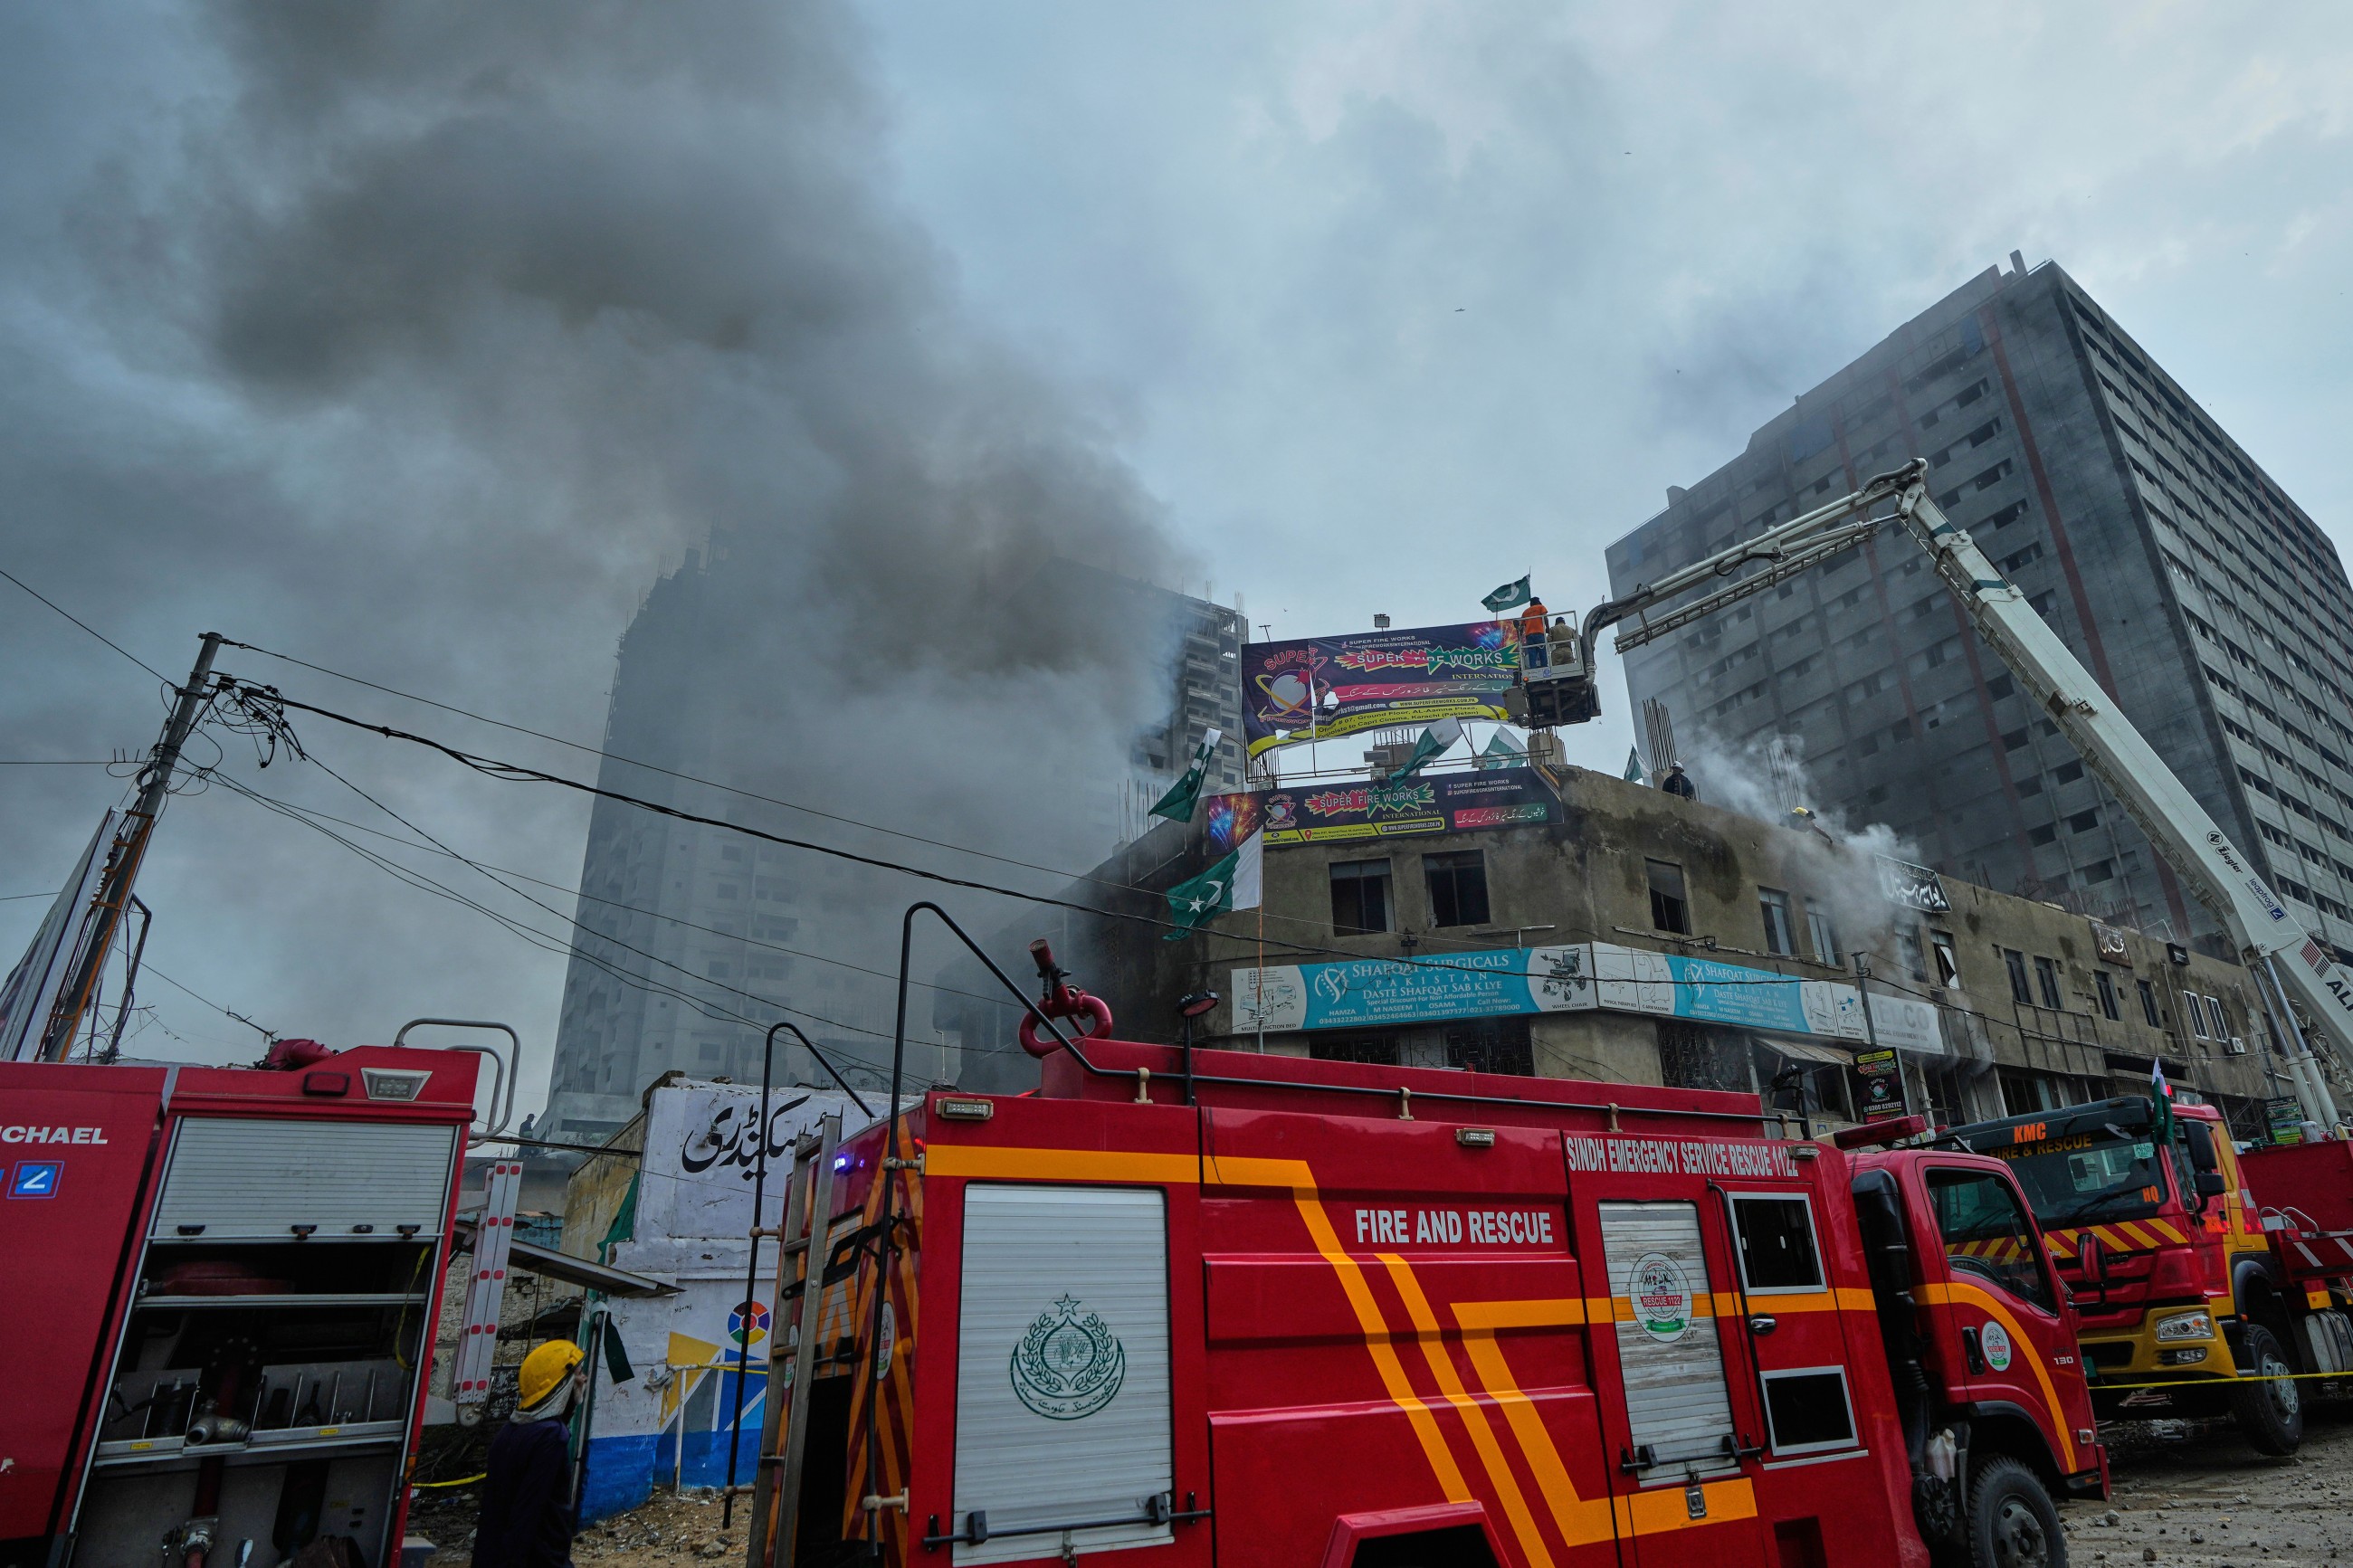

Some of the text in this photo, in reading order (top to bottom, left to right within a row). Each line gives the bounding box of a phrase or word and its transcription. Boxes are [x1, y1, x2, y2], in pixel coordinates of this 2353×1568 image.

[1450, 653, 1503, 664] WORKS
[1400, 698, 1476, 707] WWW.SUPERFIREWORKS.COM.PK
[1358, 711, 1386, 721] Ground
[1389, 708, 1411, 717] Floor,
[1453, 784, 1522, 795] SUPERFIREWORKSINTERNATIONAL
[1320, 791, 1419, 808] SUPER FIRE WORKS
[1383, 810, 1442, 820] INTERNATIONAL
[1388, 821, 1441, 832] WWW.SUPERFIREWORKS.COM.PK
[2215, 846, 2243, 874] Ziegler
[2249, 878, 2275, 908] leapfrog
[1353, 955, 1509, 979] SHAFQAT SURGICALS
[1705, 965, 1744, 980] SHAFQAT
[1376, 973, 1487, 987] PAKISTAN
[1363, 980, 1502, 1000] DASTE SHAFQAT SAB K LYE
[1379, 1004, 1413, 1012] NASEEM
[1491, 997, 1511, 1005] Now:
[1389, 996, 1416, 1004] Discount
[1444, 992, 1477, 1000] Affordable
[1871, 1078, 1886, 1086] SUPER
[2014, 1122, 2046, 1144] KMC
[2023, 1145, 2033, 1157] &
[2036, 1133, 2092, 1155] RESCUE
[1567, 1136, 1606, 1172] SINDH
[1606, 1139, 1678, 1174] EMERGENCY
[1681, 1142, 1729, 1175] SERVICE
[1729, 1145, 1773, 1176] RESCUE
[2142, 1185, 2159, 1203] HQ
[1356, 1209, 1553, 1244] FIRE AND RESCUE
[1643, 1297, 1681, 1307] RESCUE 1122
[2053, 1356, 2073, 1365] 130
